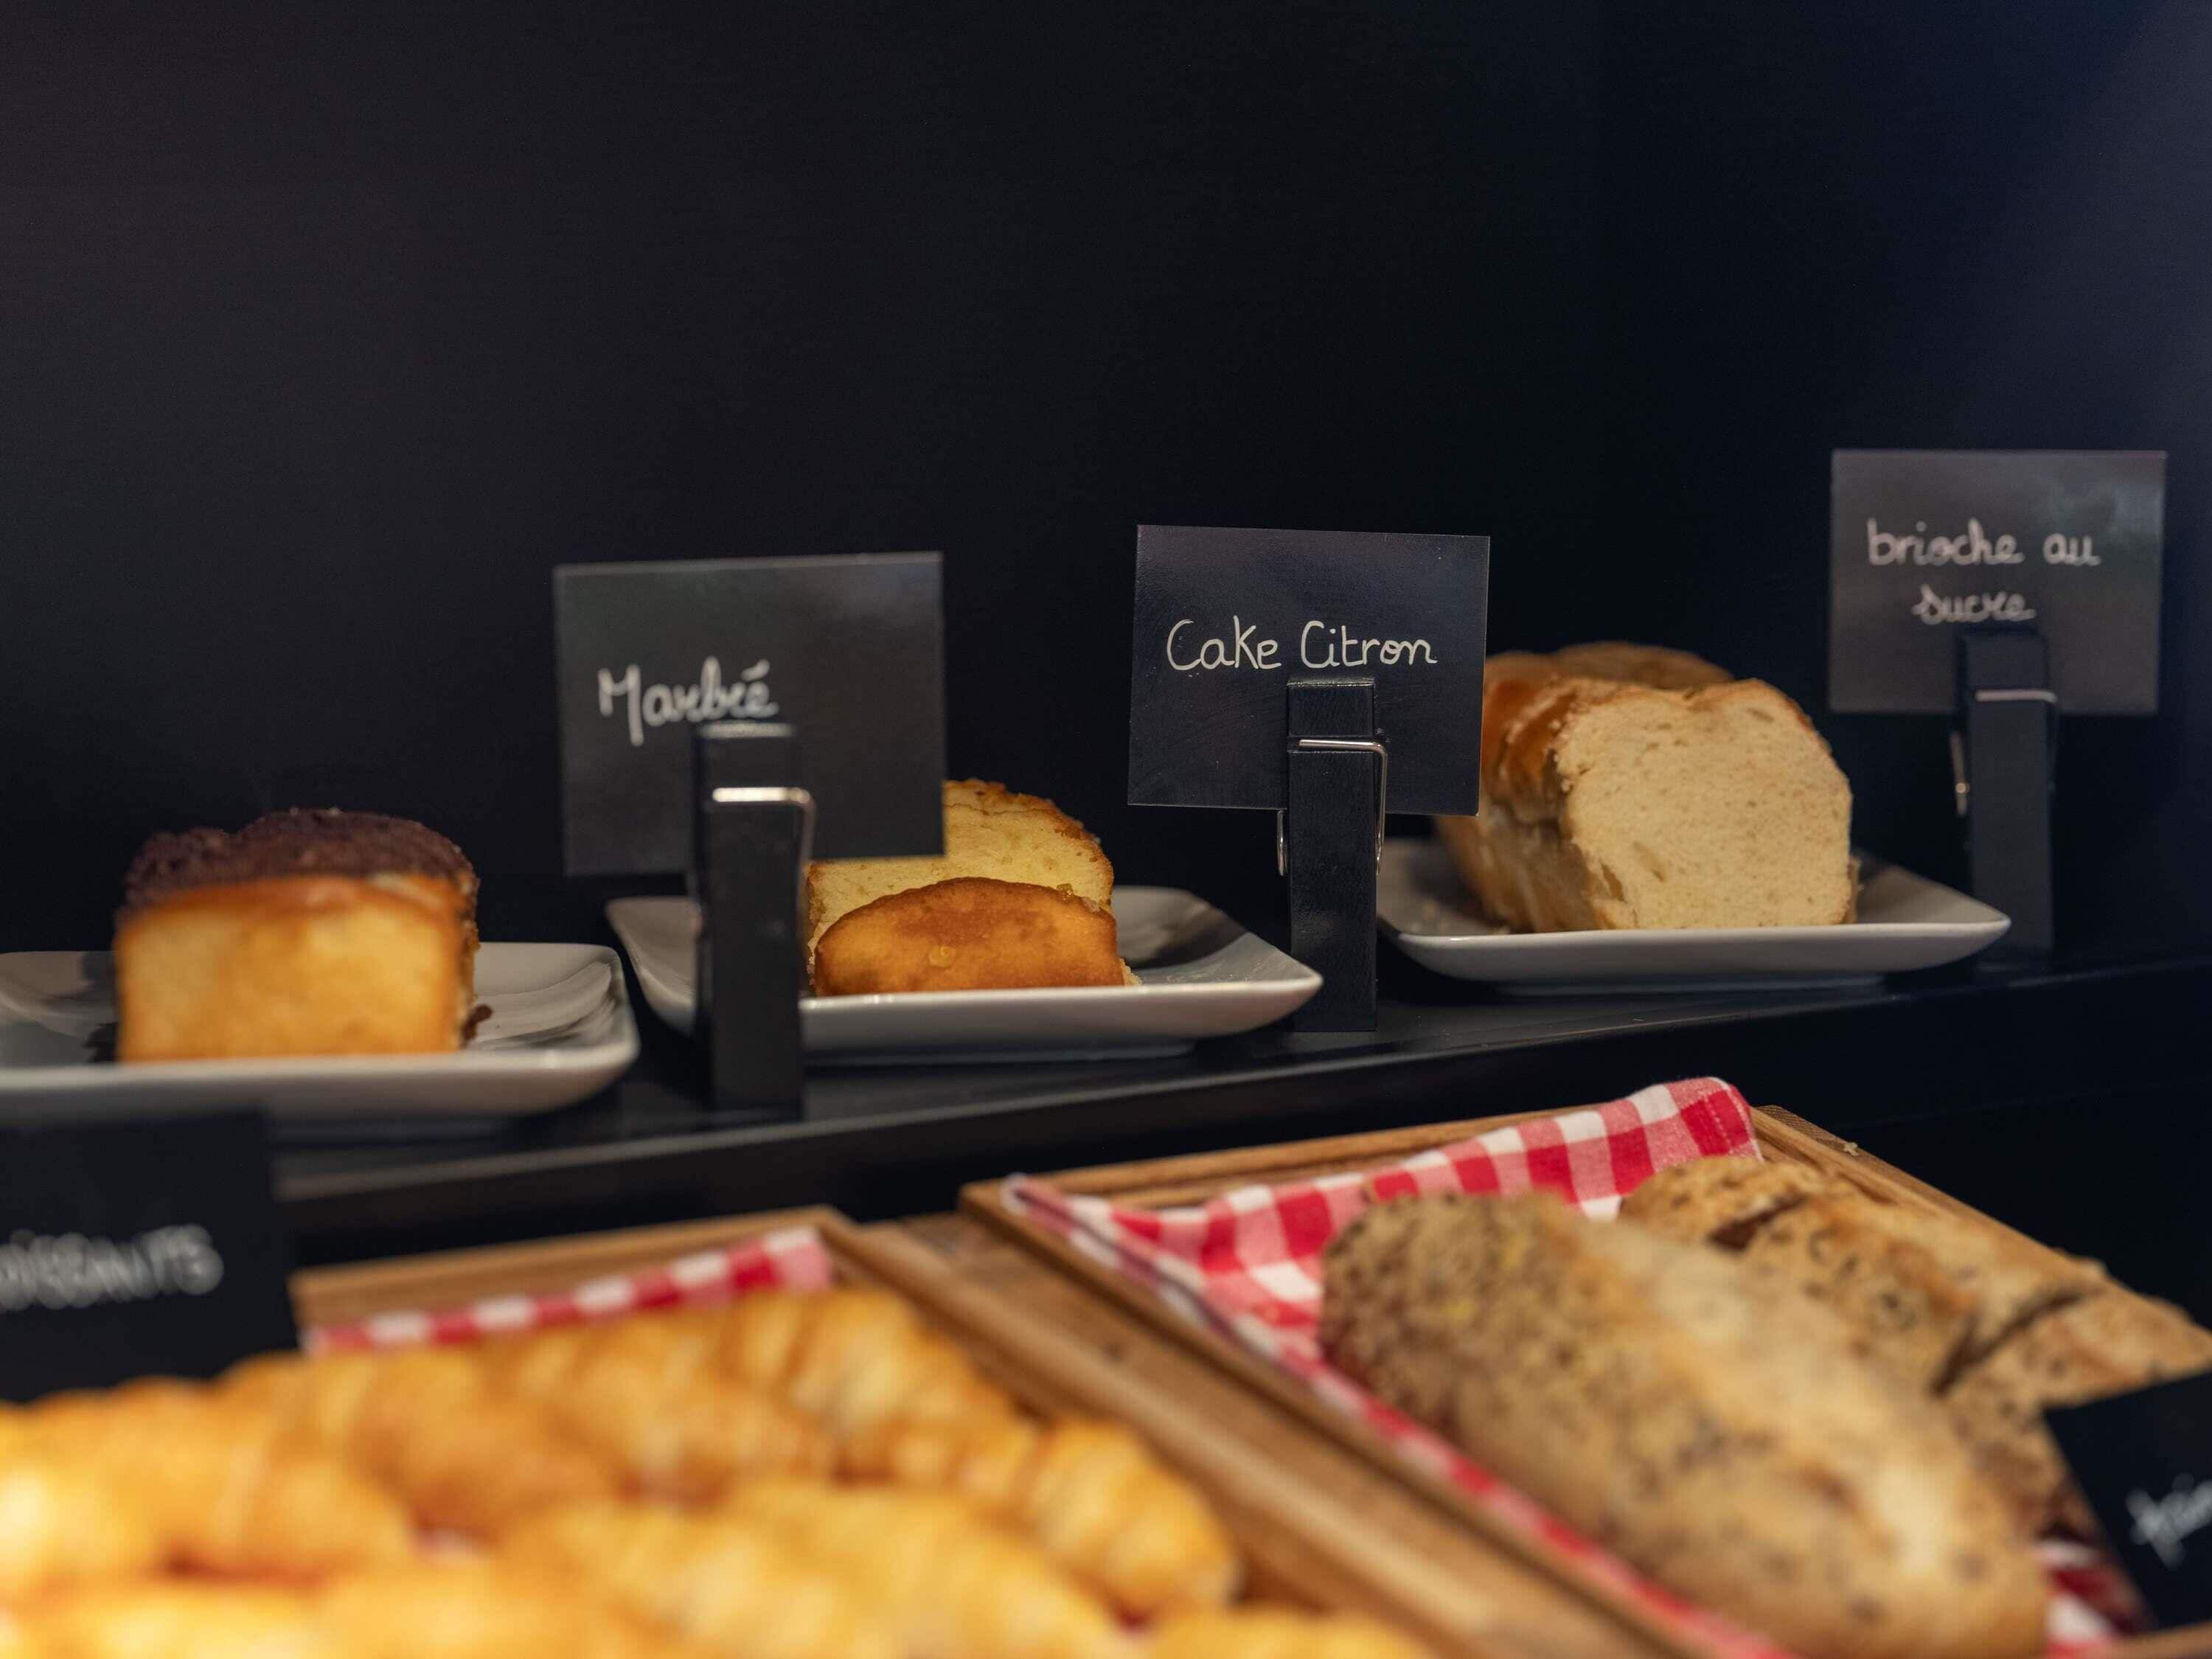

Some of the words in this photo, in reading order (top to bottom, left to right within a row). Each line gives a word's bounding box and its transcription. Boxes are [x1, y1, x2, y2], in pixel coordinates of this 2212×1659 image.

[1867, 518, 2024, 566] brioche
[2042, 533, 2101, 566] au
[1166, 616, 1283, 671] Cake
[1300, 620, 1438, 669] Citron
[597, 656, 779, 746] Marbré
